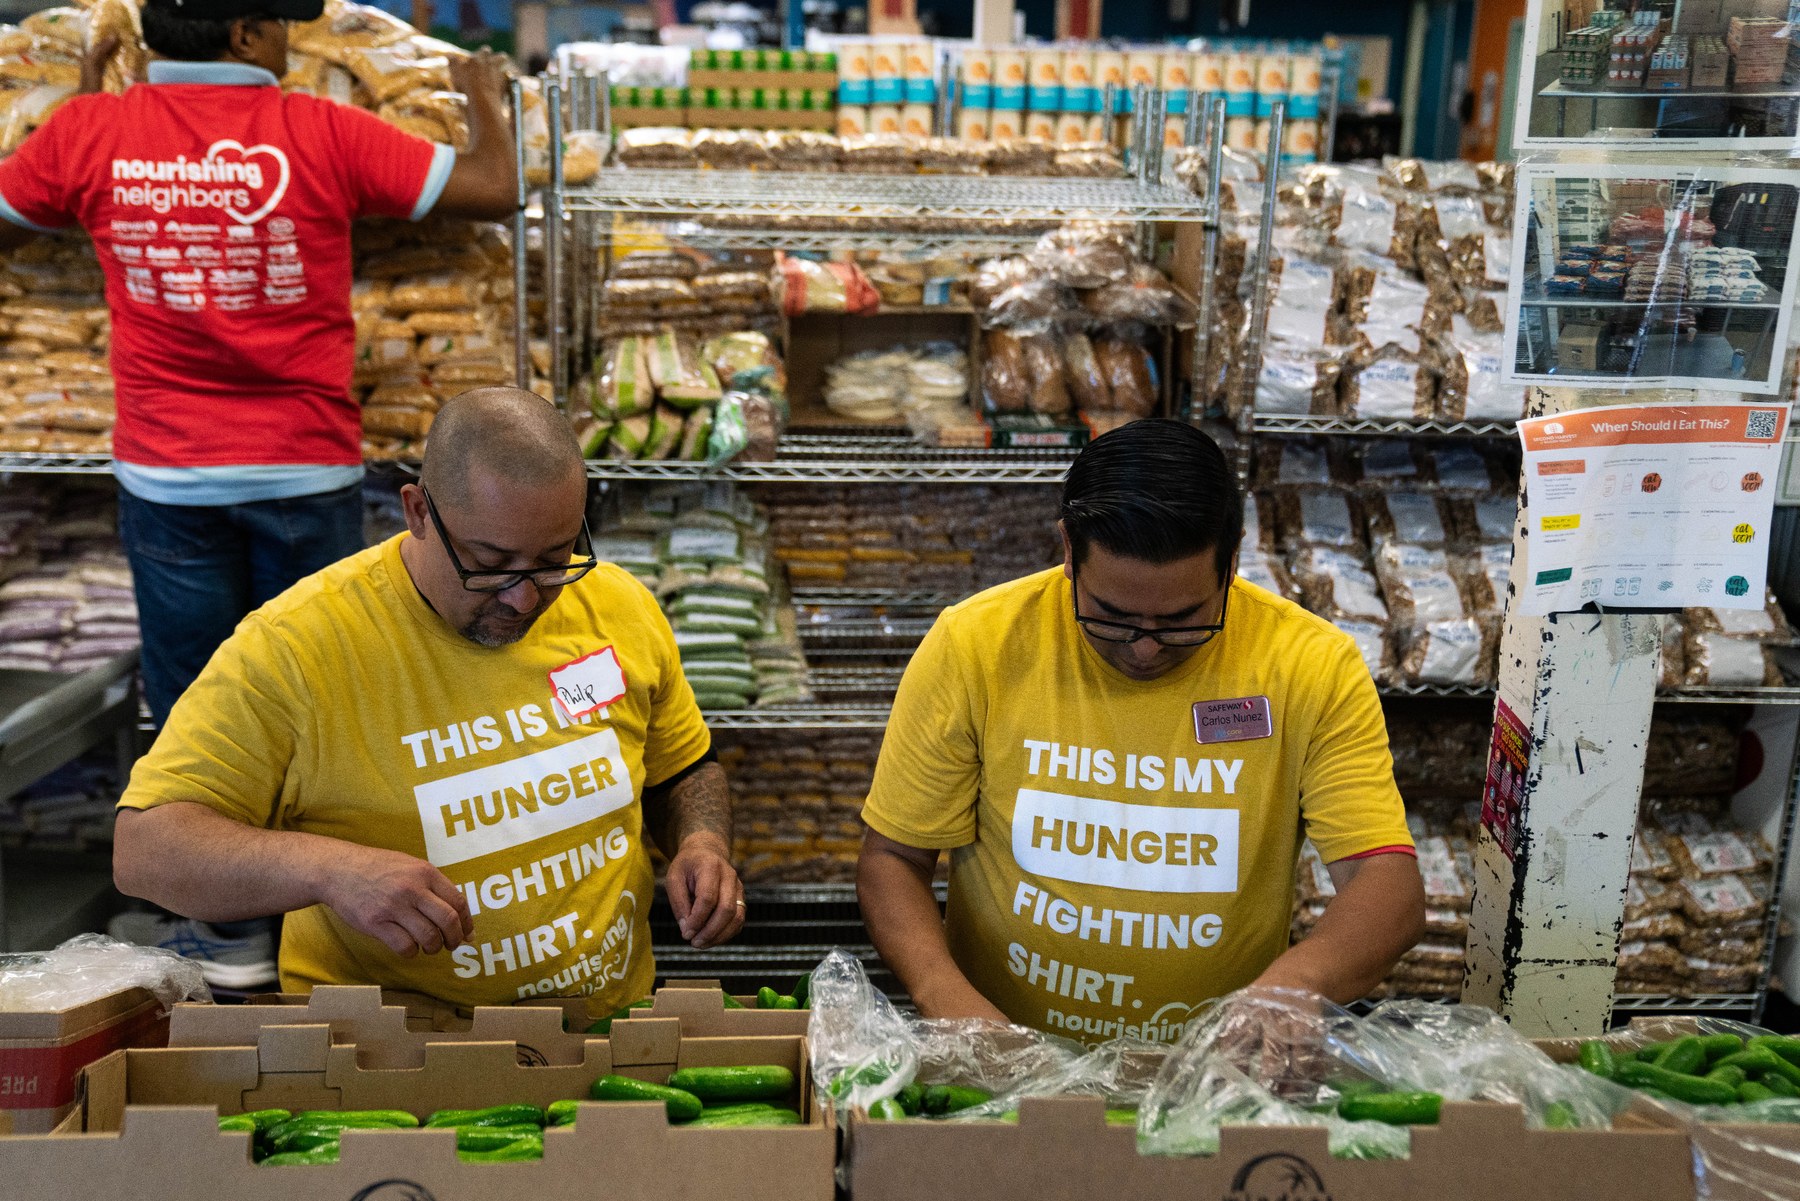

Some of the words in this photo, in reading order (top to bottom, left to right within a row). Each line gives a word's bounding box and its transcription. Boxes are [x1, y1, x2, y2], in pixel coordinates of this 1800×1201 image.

[112, 155, 263, 189] nourishing
[112, 182, 250, 214] neighbors
[1591, 422, 1629, 433] When
[1630, 420, 1670, 431] Should
[1673, 420, 1677, 430] I
[1679, 420, 1696, 430] Eat
[1698, 418, 1729, 430] This?
[1744, 471, 1758, 481] eat
[1732, 531, 1755, 543] soon!
[1735, 523, 1749, 533] eat
[1201, 715, 1231, 727] Carlos
[1232, 713, 1263, 723] Nunez
[1208, 702, 1242, 713] SAFEWAY
[401, 715, 503, 769] THIS
[504, 703, 548, 743] IS
[1023, 739, 1117, 785] THIS
[1125, 754, 1165, 791] IS
[1173, 757, 1244, 794] MY
[439, 756, 619, 839] HUNGER
[1031, 815, 1219, 867] HUNGER
[455, 826, 629, 917] IGHTING
[1012, 881, 1223, 950] FIGHTING
[451, 911, 594, 979] SHIRT.
[1007, 942, 1143, 1009] SHIRT.
